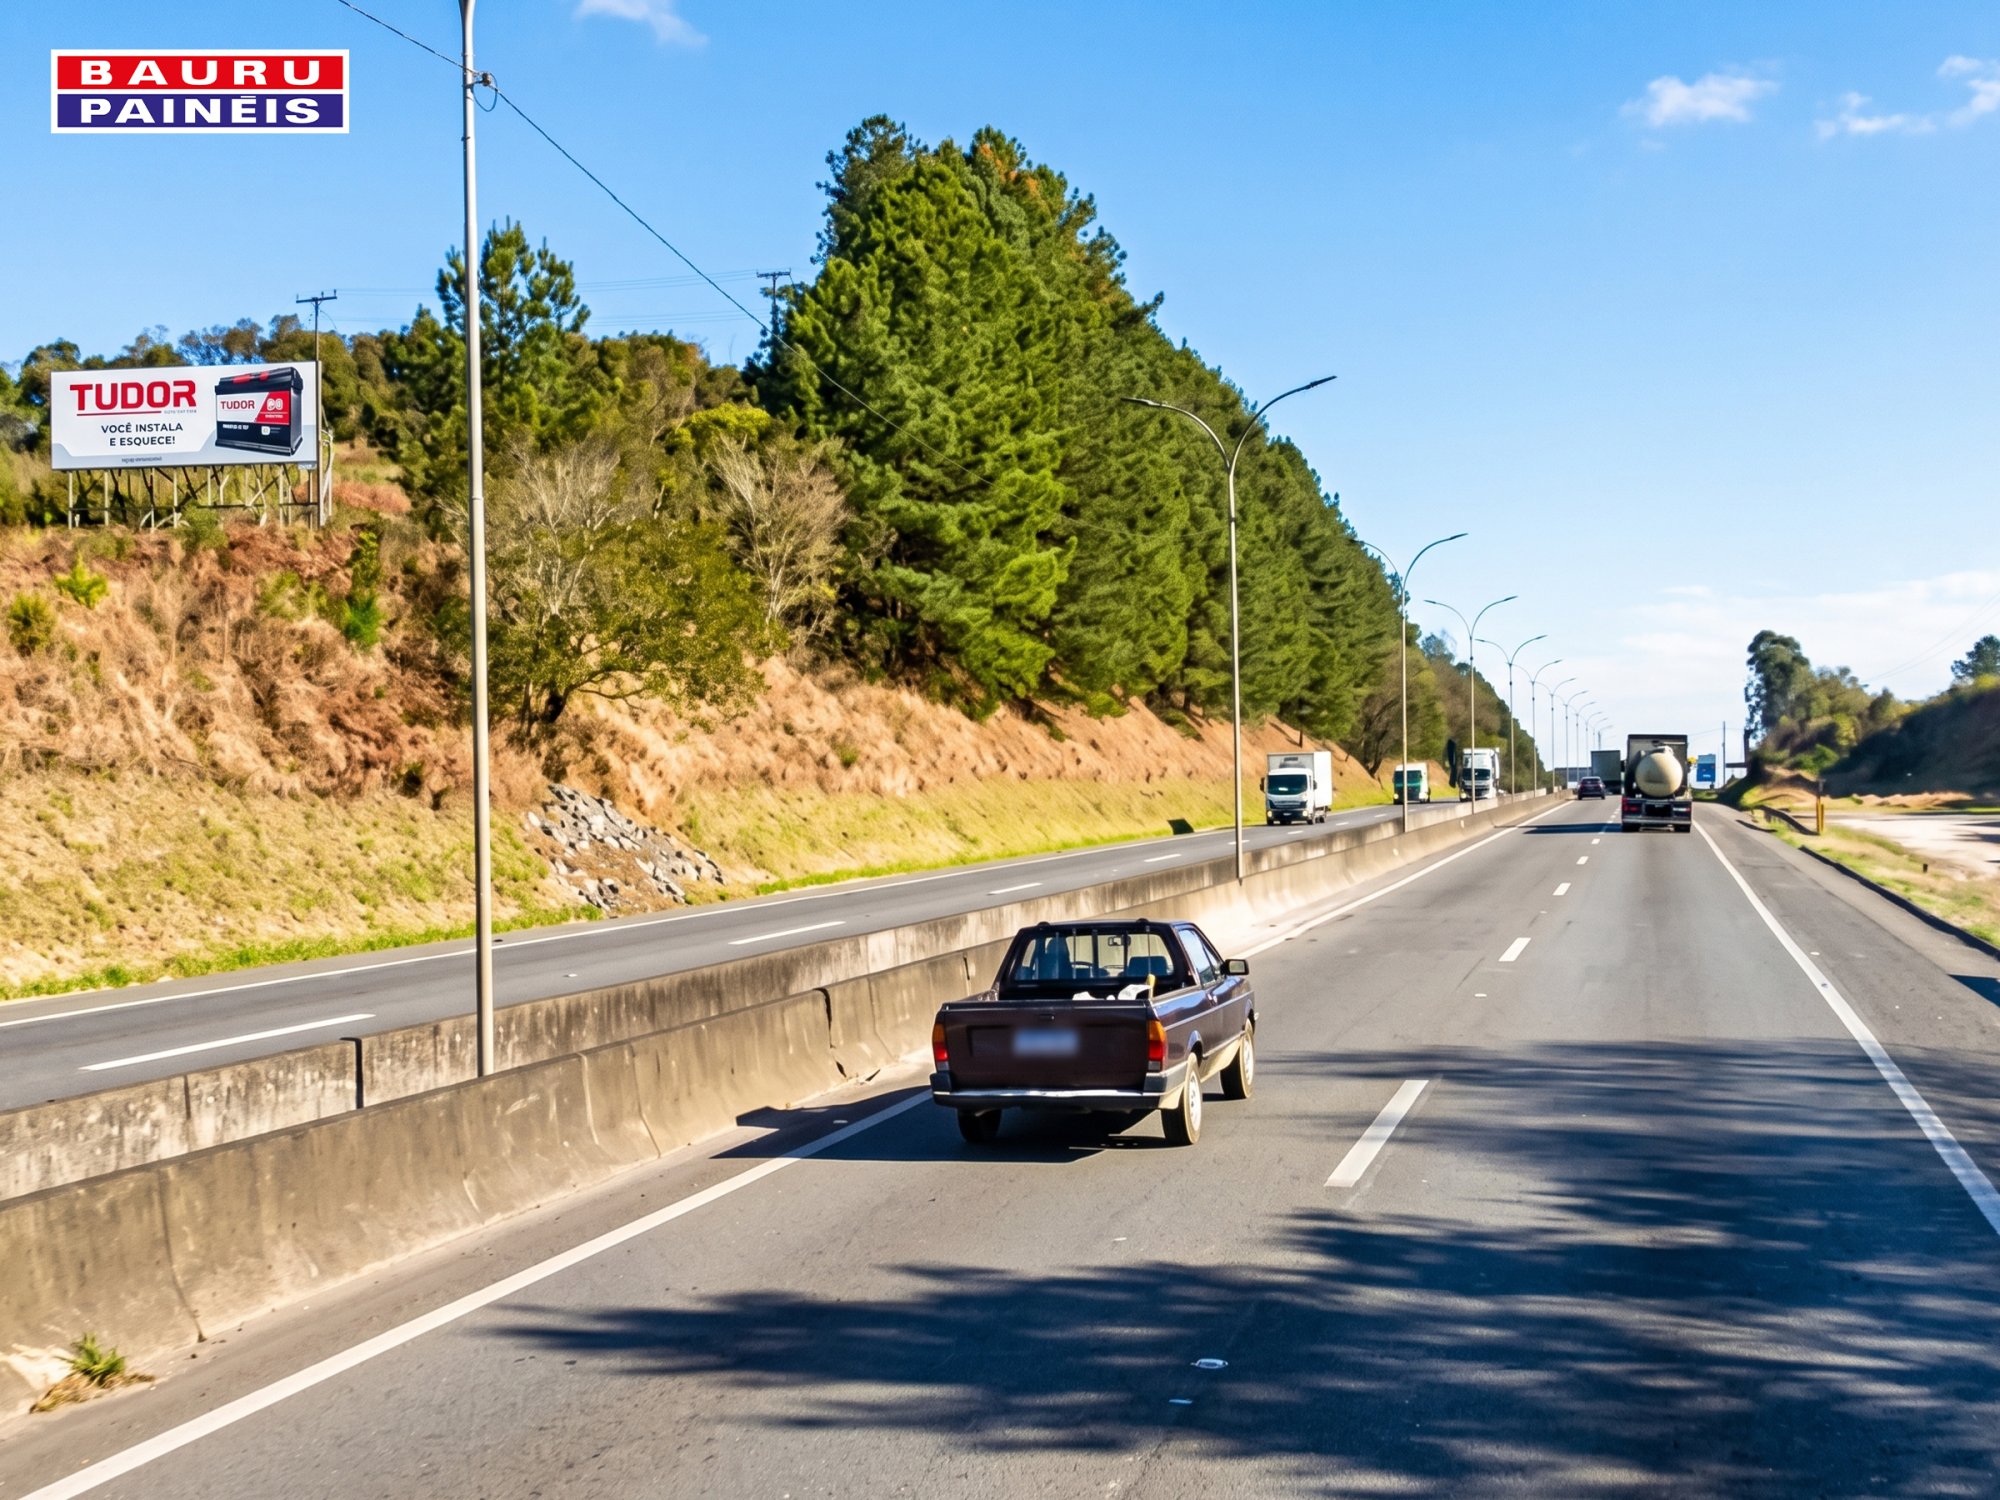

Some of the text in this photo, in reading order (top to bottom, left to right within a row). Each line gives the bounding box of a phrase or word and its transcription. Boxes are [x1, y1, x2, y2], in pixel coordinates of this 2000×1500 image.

[69, 380, 197, 411] TUDOR
[220, 400, 255, 410] TUDOR
[101, 422, 183, 433] VOCÊ INSTALA
[109, 436, 176, 446] E ESQUECE!
